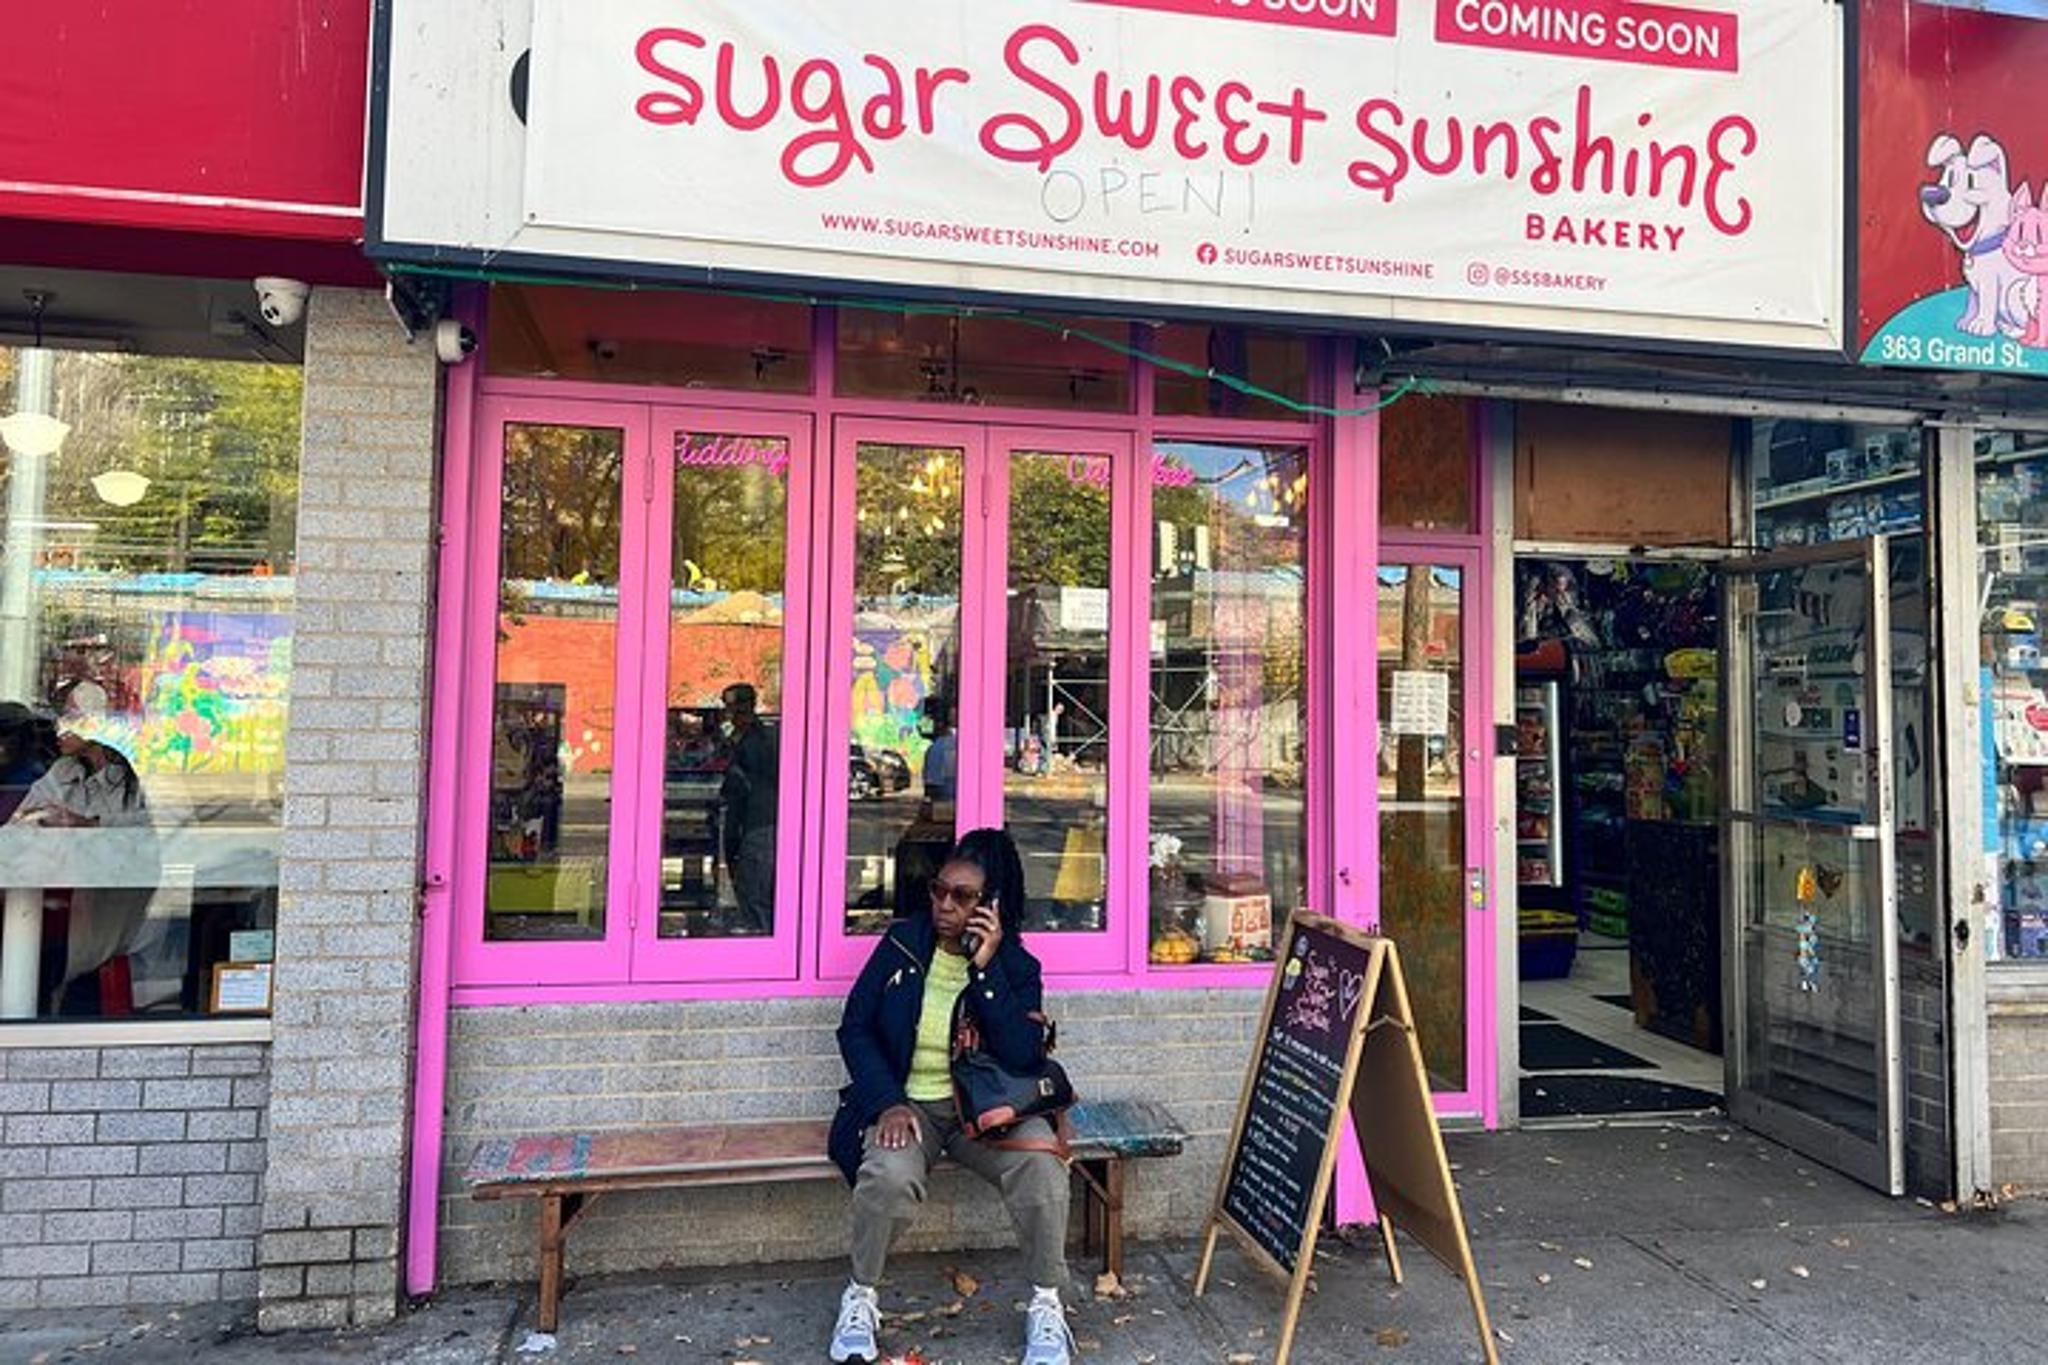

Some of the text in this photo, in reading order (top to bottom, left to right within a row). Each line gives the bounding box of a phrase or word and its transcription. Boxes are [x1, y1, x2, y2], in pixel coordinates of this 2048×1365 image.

[1455, 0, 1720, 58] COMING SOON
[821, 213, 1160, 257] WWW.SUGARSWEETSUNSHINE.COM
[1525, 214, 1685, 251] BAKERY
[1224, 248, 1434, 279] SUGARSWEETSUNSHINE
[1495, 268, 1607, 291] @SSSBAKERY
[1882, 335, 2029, 367] 363 Grand St.
